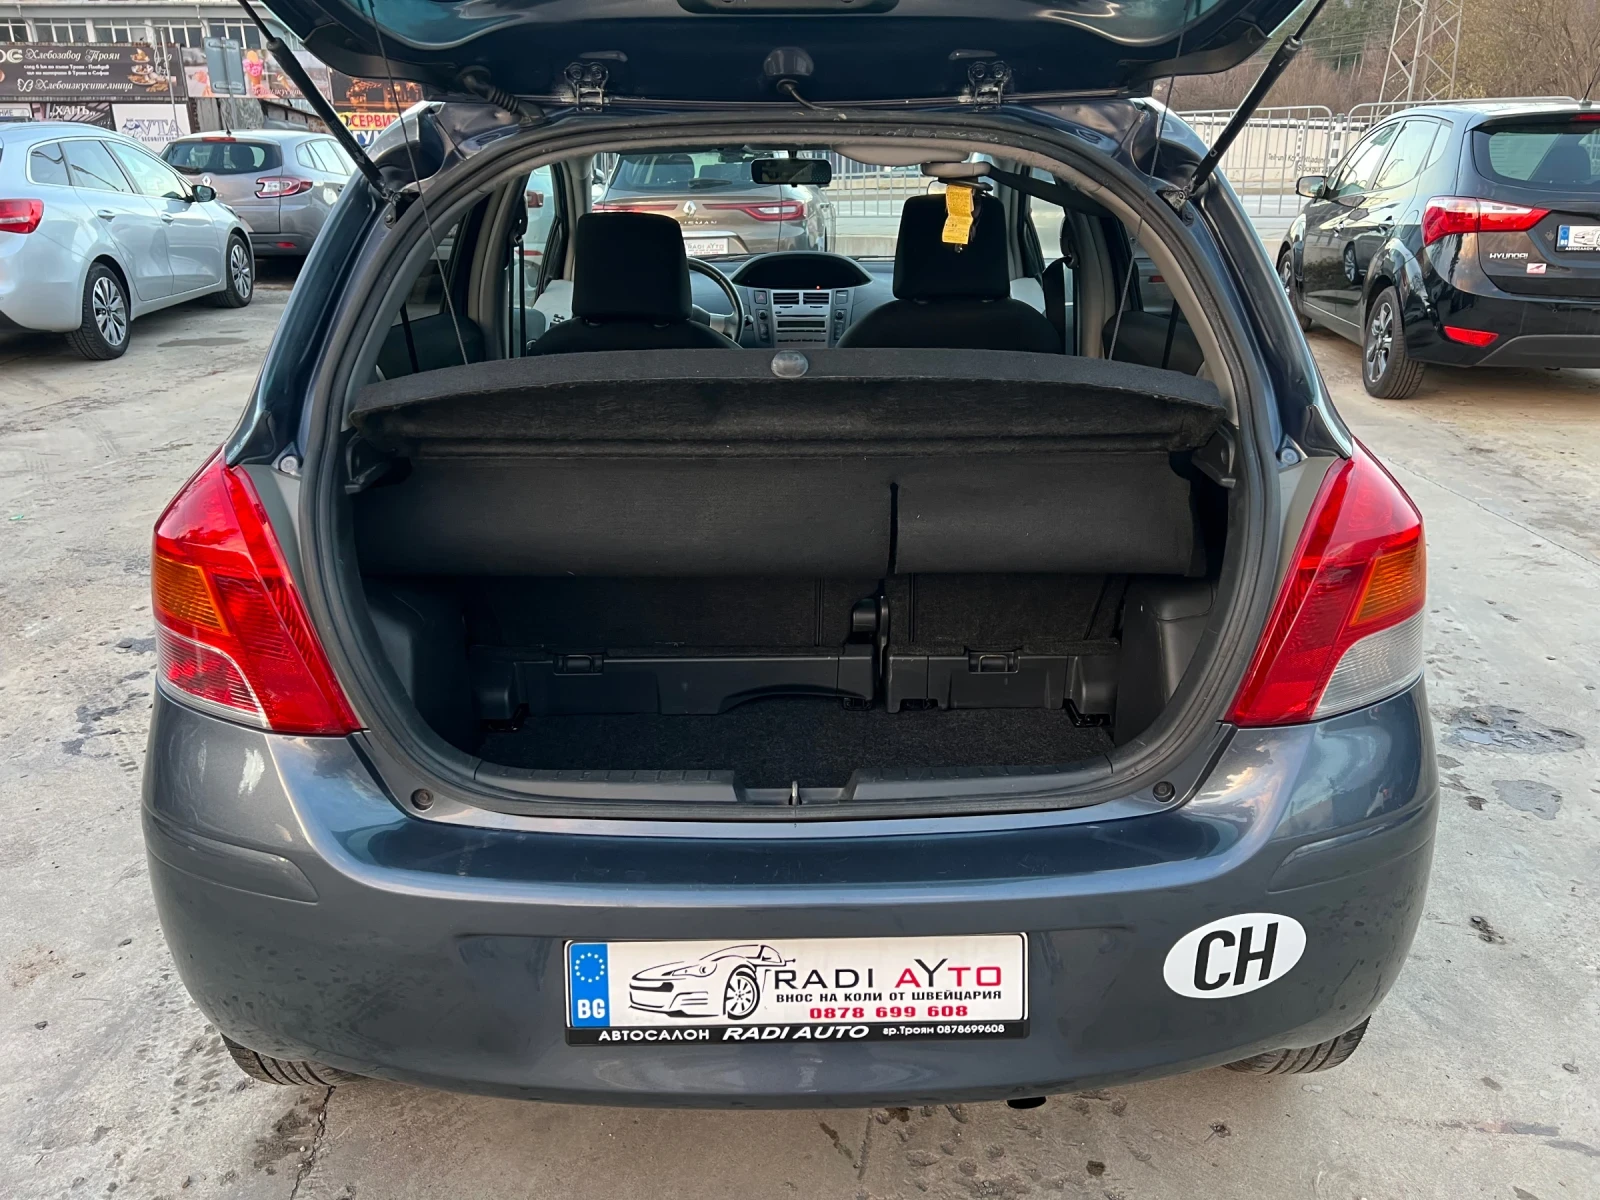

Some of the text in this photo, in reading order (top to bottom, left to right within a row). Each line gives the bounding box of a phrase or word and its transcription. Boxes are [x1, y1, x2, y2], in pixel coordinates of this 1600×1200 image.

[25, 48, 120, 62] Хлебозавод Троян
[1194, 922, 1279, 991] CH
[774, 968, 873, 989] RADI
[776, 989, 1002, 1003] ВНОС НА КОЛИ ОТ ШВЕЙЦАРИЯ
[577, 998, 606, 1019] BG
[809, 1005, 968, 1019] 0878 699 608
[599, 1029, 710, 1041] АВТОСАЛОН
[722, 1027, 790, 1041] RADI
[793, 1025, 870, 1039] AUTO
[937, 1024, 1005, 1035] 0878699608
